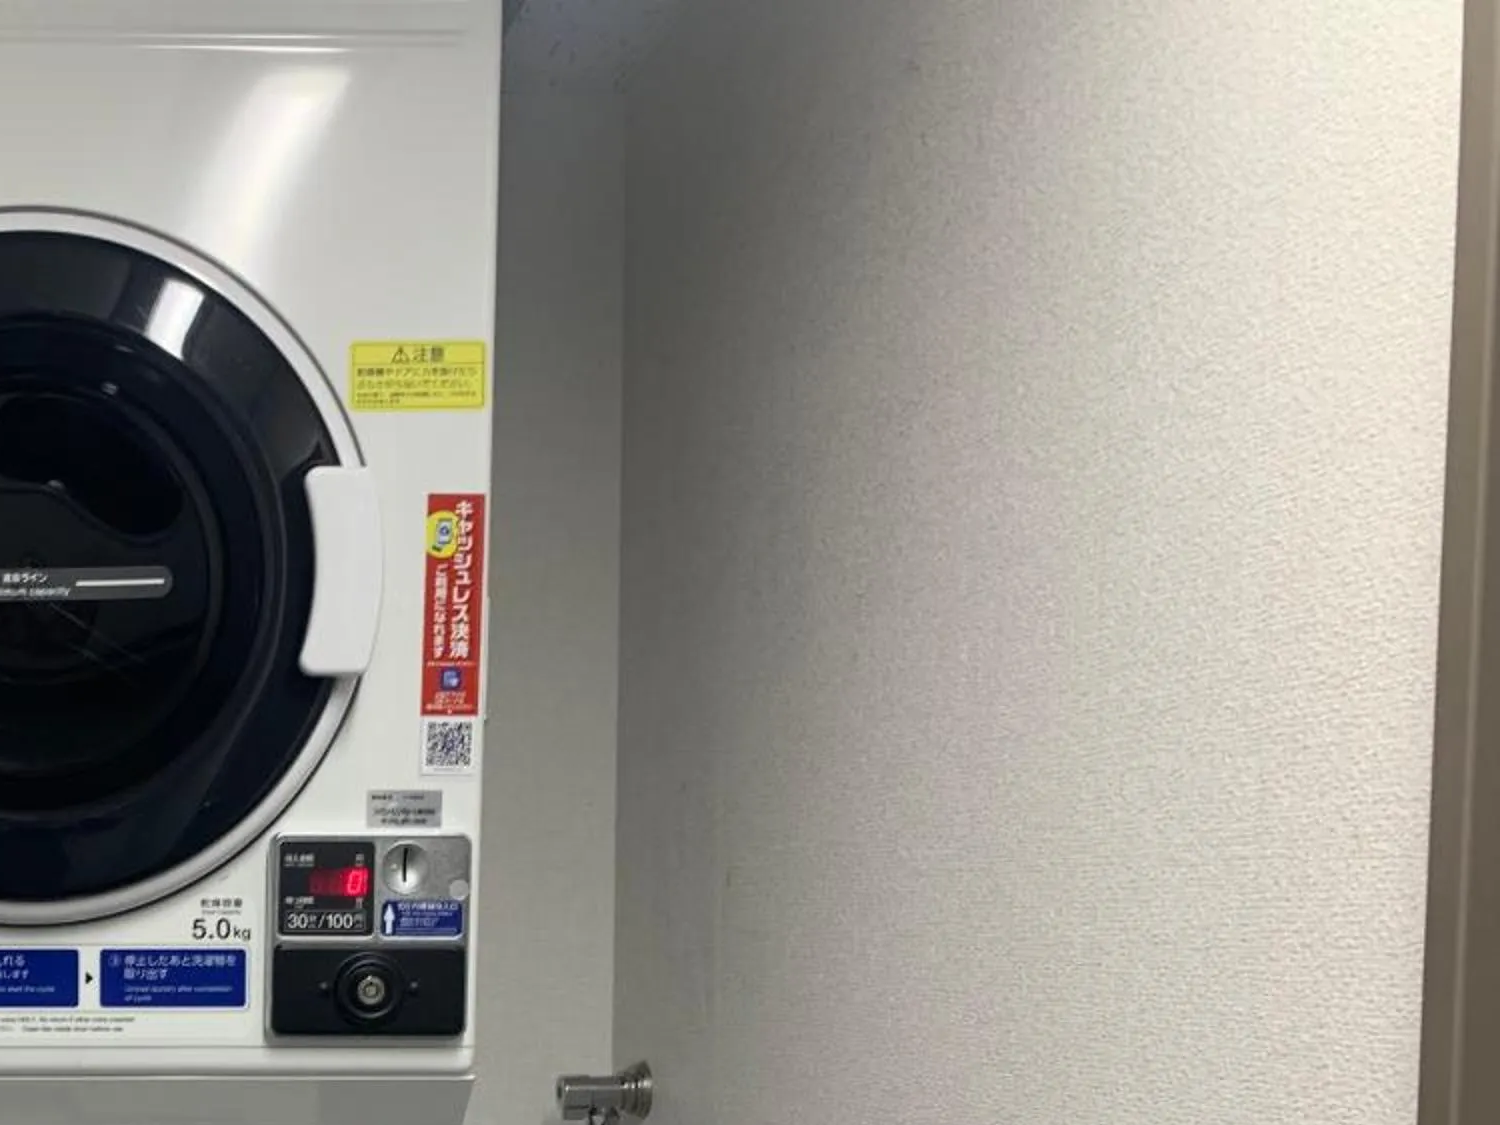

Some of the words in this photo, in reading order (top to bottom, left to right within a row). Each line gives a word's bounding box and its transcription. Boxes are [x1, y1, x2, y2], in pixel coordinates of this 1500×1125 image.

[449, 500, 474, 659] キャッシュレス決済
[347, 868, 366, 896] 0
